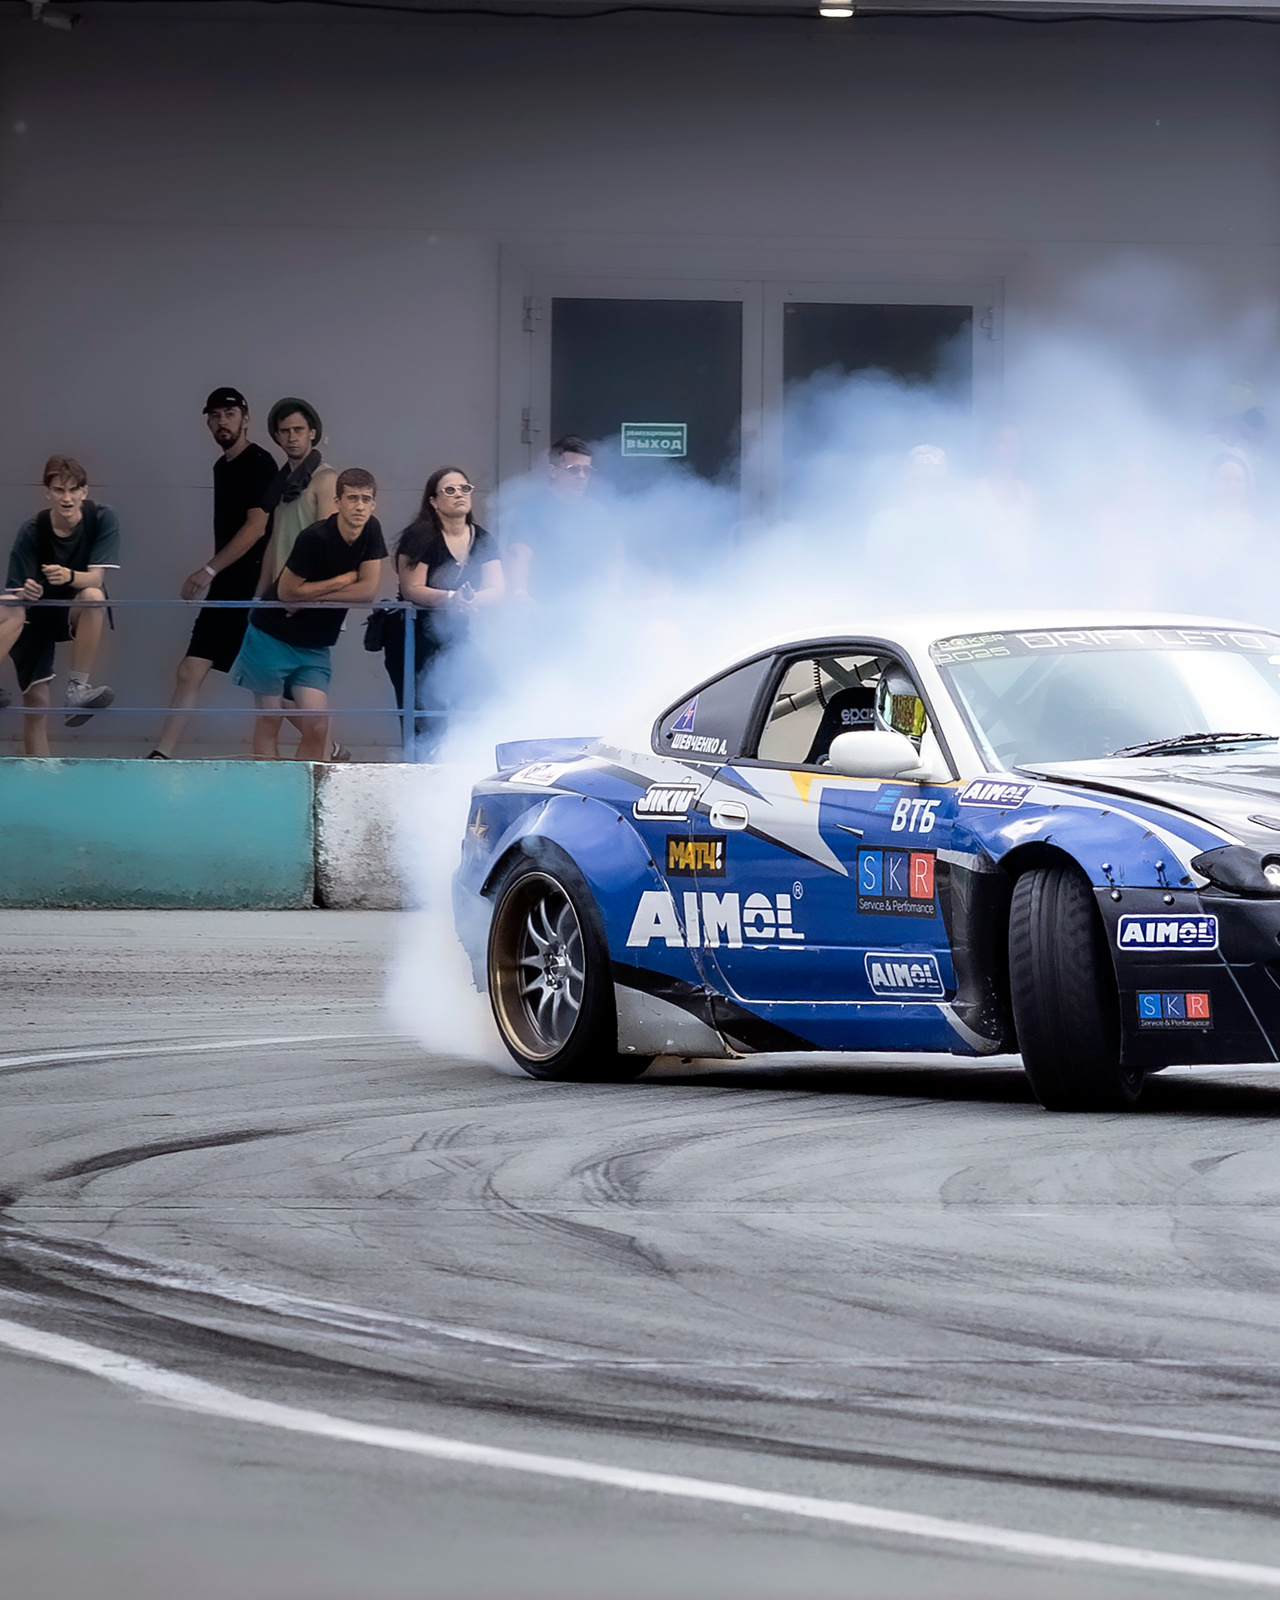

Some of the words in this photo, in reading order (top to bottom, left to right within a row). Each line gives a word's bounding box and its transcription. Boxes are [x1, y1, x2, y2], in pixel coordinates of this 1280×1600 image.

[626, 439, 682, 450] ВЫХОД
[1015, 630, 1147, 649] DRIFT
[1152, 630, 1268, 650] LETO
[935, 646, 1011, 664] 2025
[671, 733, 720, 754] ШЕВЧЕНКО
[637, 789, 696, 812] JIKIU
[962, 782, 1027, 803] AIMOL
[891, 798, 942, 833] ВТБ
[669, 841, 722, 869] МАТЧ!
[863, 855, 929, 893] SKR
[859, 898, 884, 911] Service
[885, 900, 892, 911] &
[1122, 922, 1214, 943] AIMOL
[871, 963, 940, 988] AIMOL
[1143, 996, 1204, 1015] SKR
